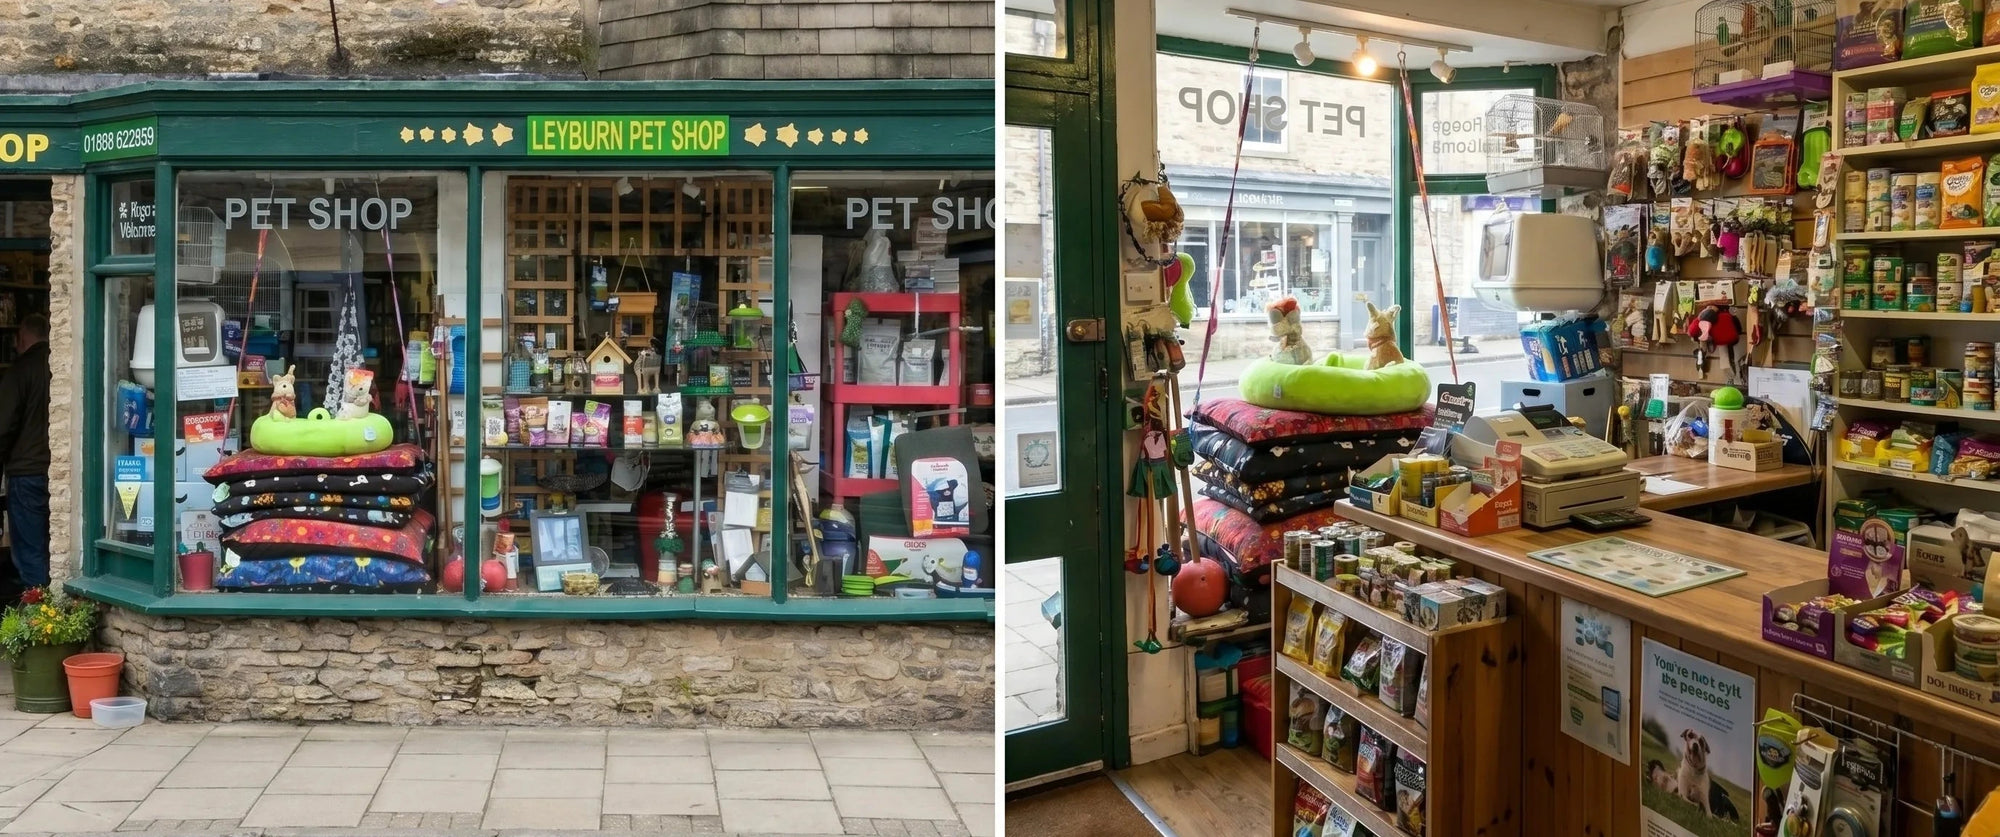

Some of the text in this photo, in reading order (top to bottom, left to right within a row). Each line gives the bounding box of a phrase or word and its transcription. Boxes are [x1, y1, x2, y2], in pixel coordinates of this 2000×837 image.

[83, 126, 155, 154] 01888 622859
[531, 120, 726, 151] LEYBURN PET SHOP
[225, 197, 413, 231] PET SHOP
[846, 197, 919, 230] PET
